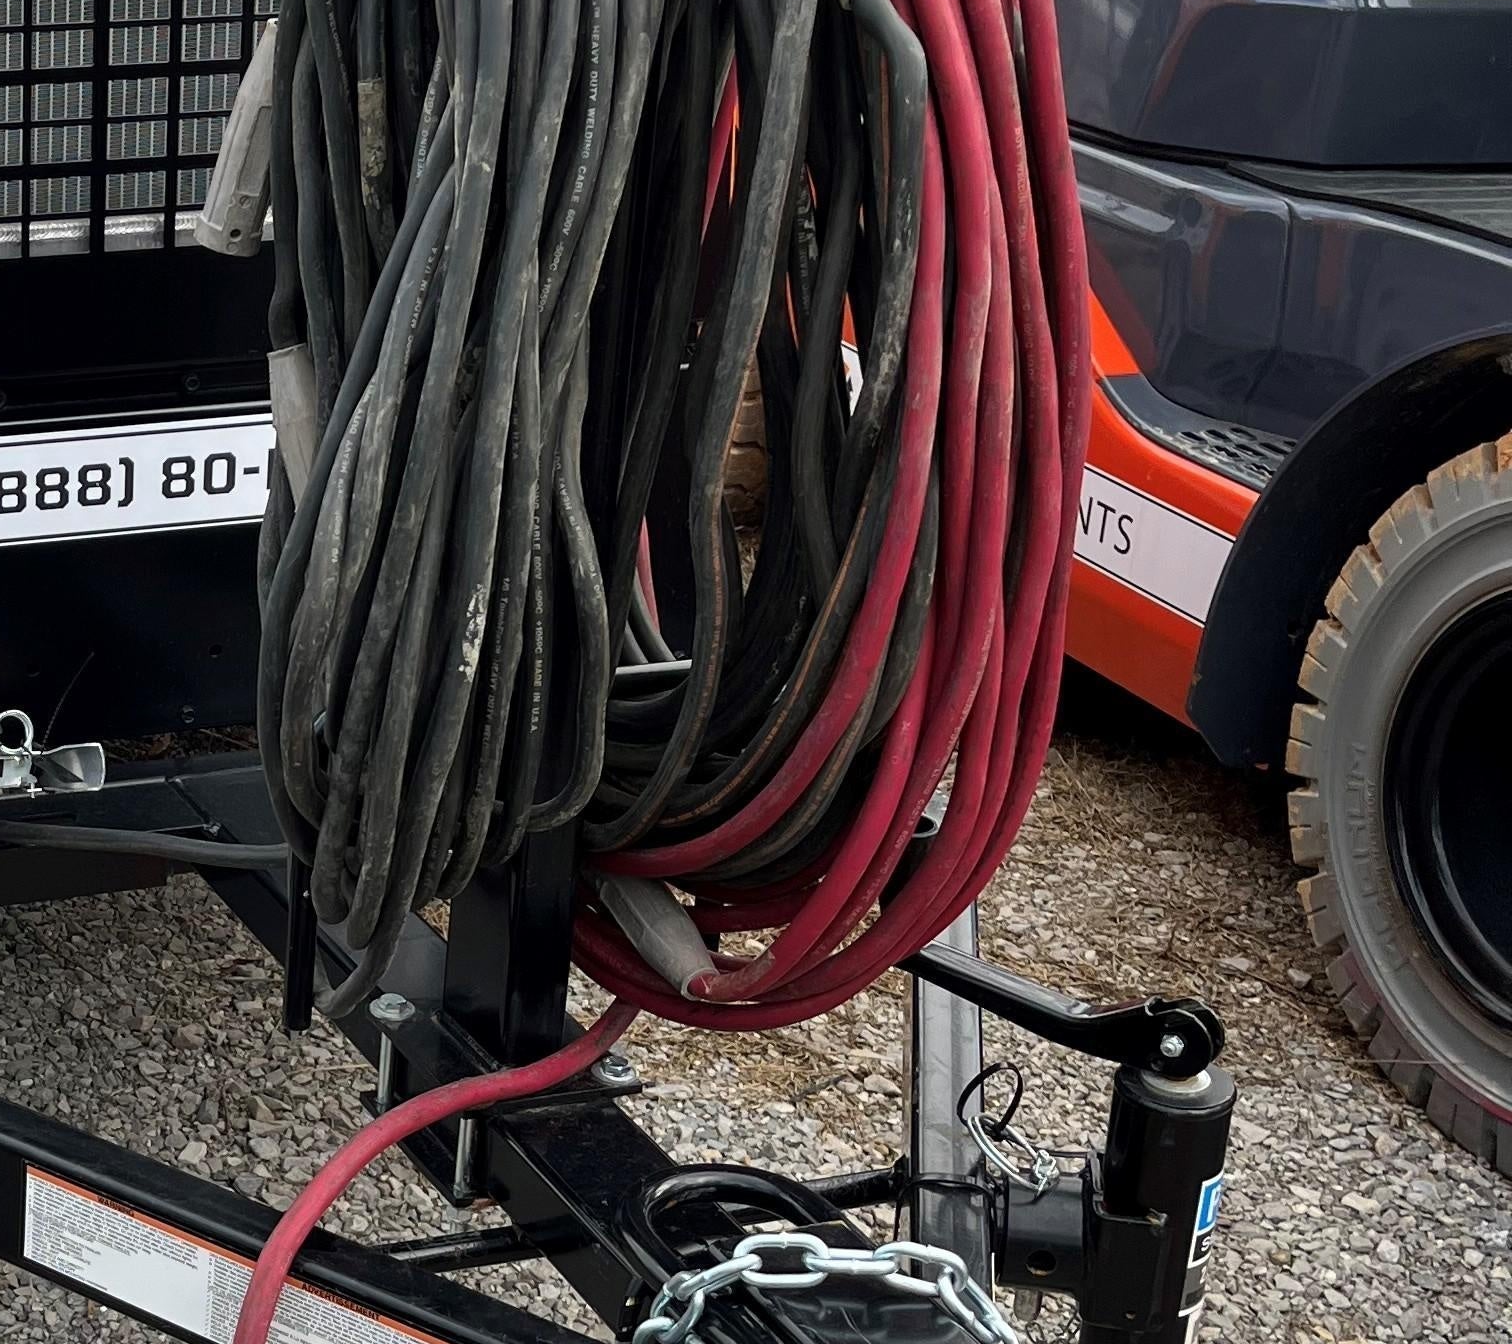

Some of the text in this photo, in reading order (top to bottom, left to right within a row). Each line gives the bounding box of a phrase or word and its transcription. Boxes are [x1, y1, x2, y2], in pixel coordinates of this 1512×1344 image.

[590, 25, 601, 65] HEAVY
[589, 71, 599, 103] DUTY
[415, 130, 429, 178] WELDING
[424, 88, 436, 123] CABLE
[582, 107, 595, 159] WELDING
[571, 166, 587, 203] CABLE
[562, 209, 576, 236] 600V
[340, 440, 354, 473] HEAVY
[349, 408, 364, 434] DUTY
[161, 452, 274, 499] 80-
[1079, 497, 1134, 555] NTS
[532, 658, 543, 687] MADE
[531, 692, 541, 703] IN
[97, 1195, 135, 1219] WARNING
[301, 1282, 381, 1322] ADVERTISSEMENT
